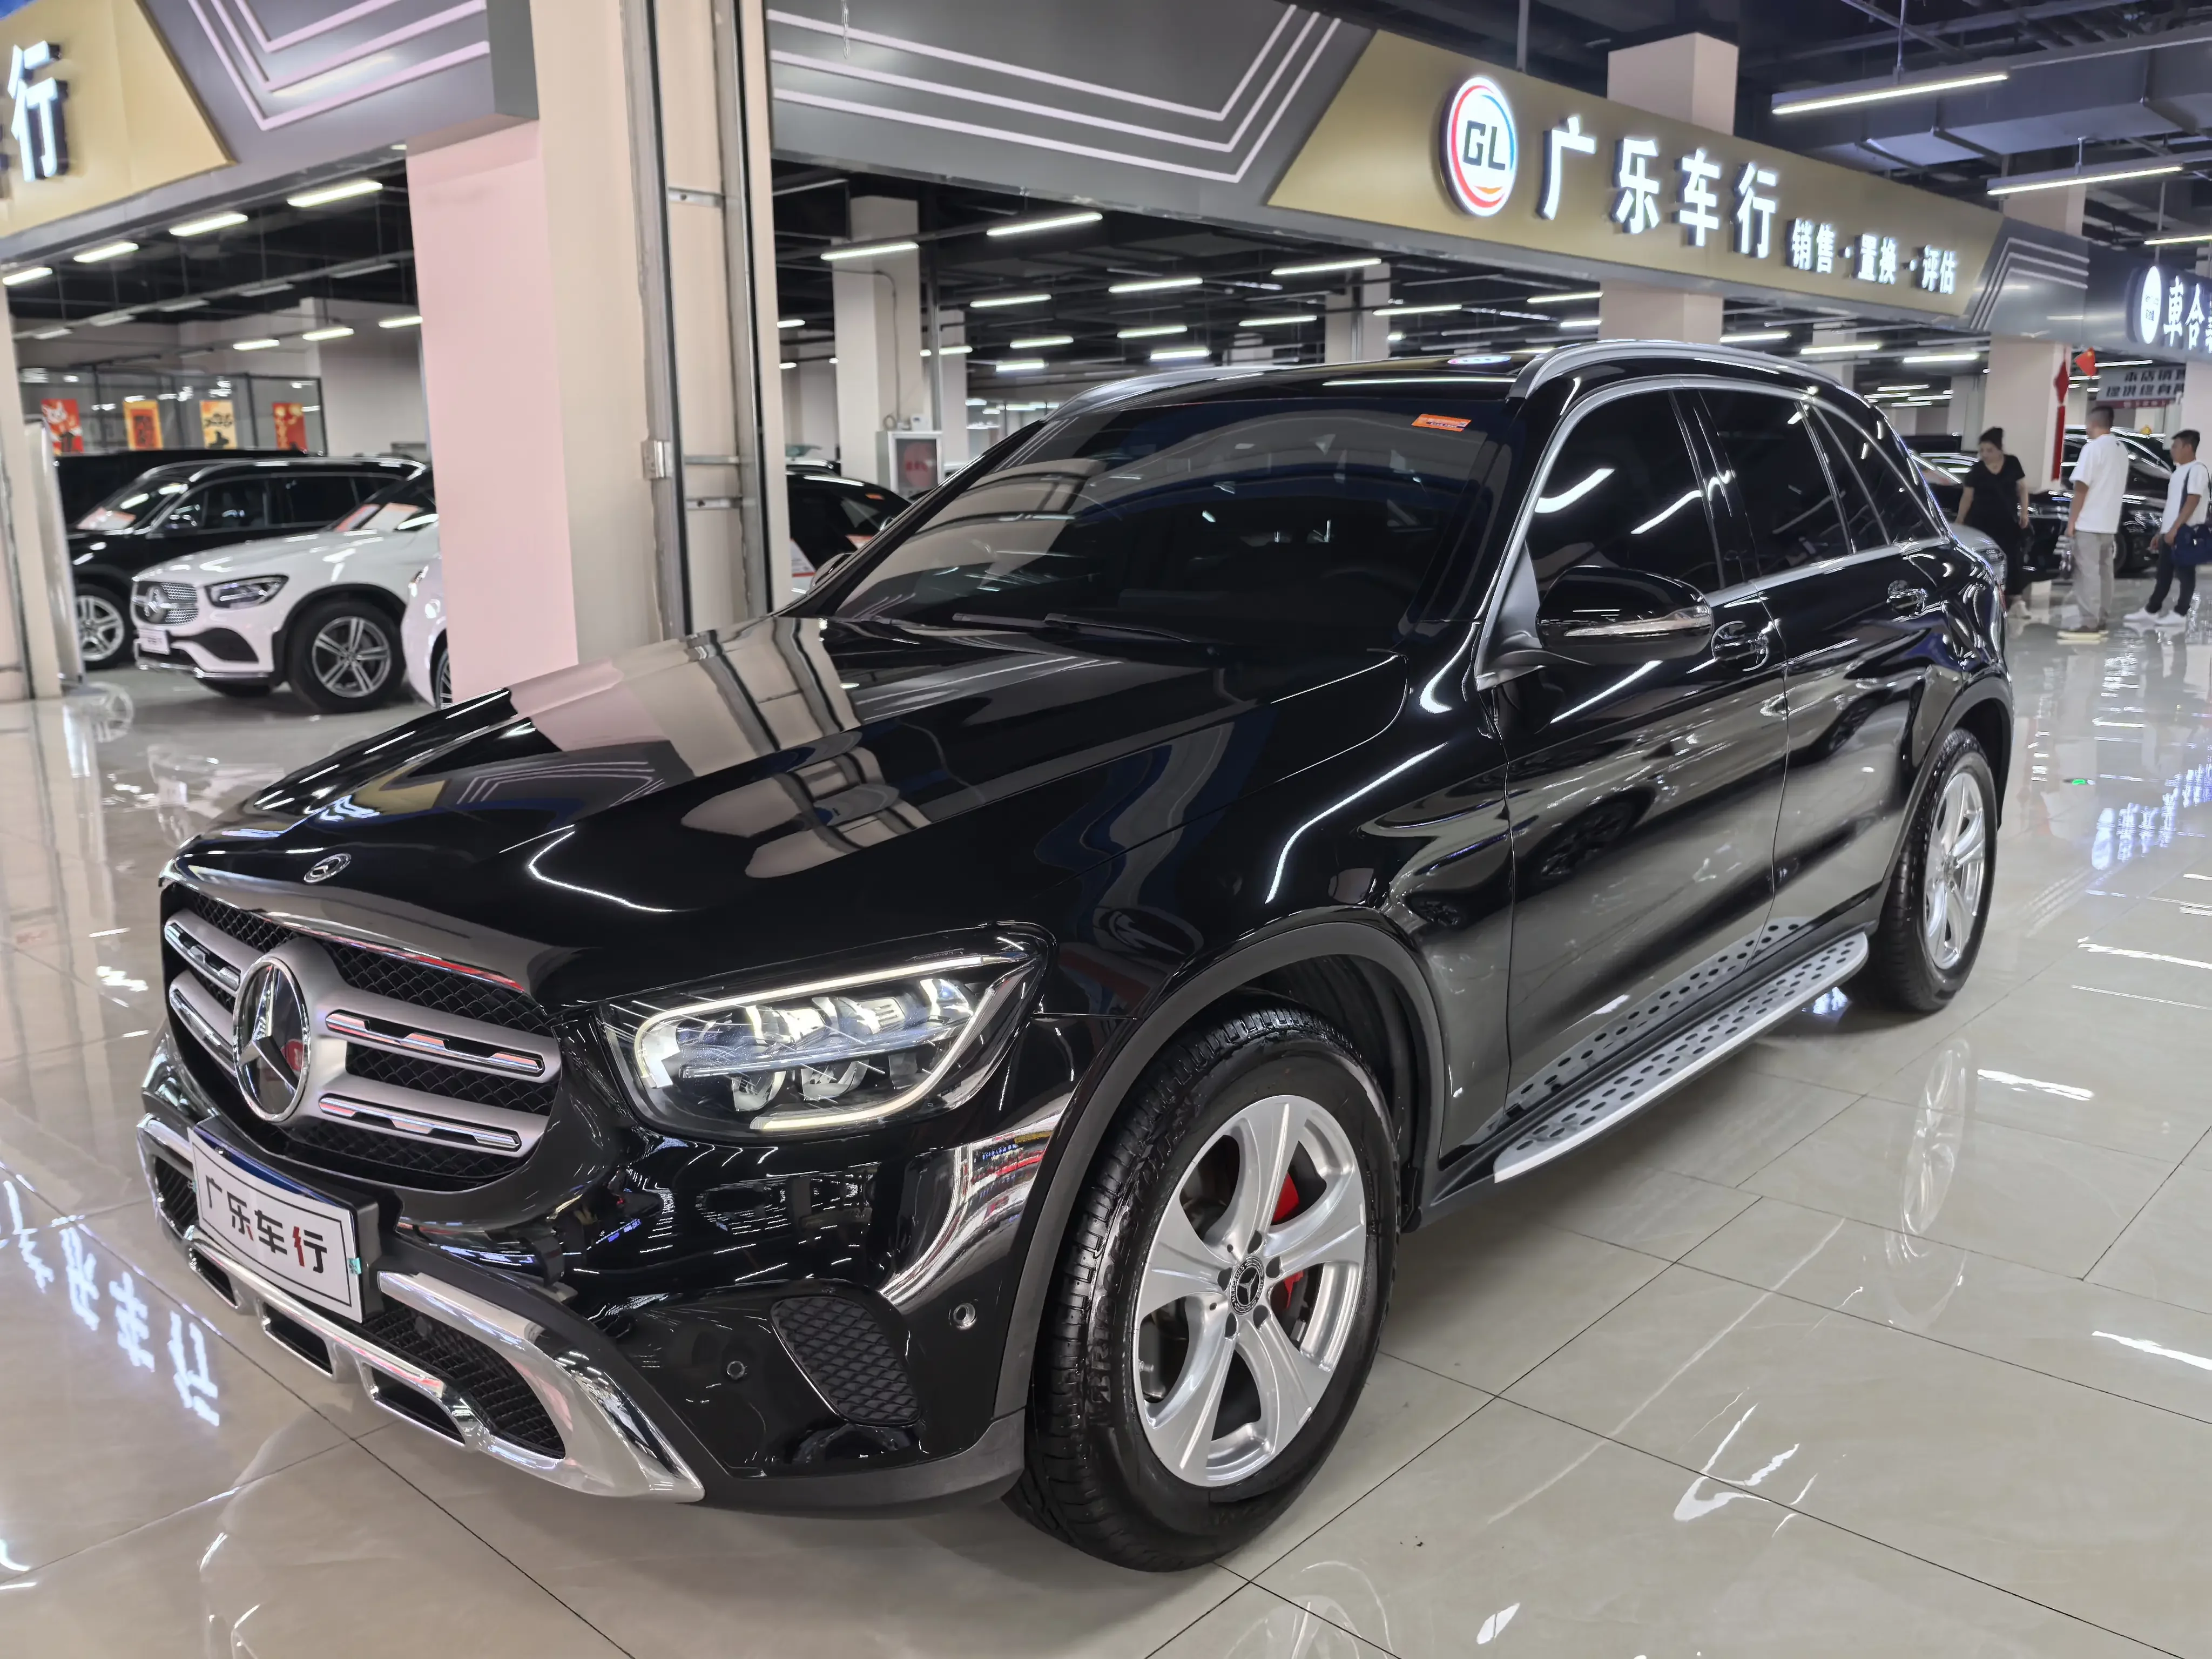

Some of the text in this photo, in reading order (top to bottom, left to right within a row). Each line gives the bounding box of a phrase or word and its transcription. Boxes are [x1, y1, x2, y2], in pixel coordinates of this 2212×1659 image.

[1462, 120, 1506, 171] GL
[1542, 113, 1778, 259] 广乐车行
[205, 1175, 328, 1274] 广乐车行
